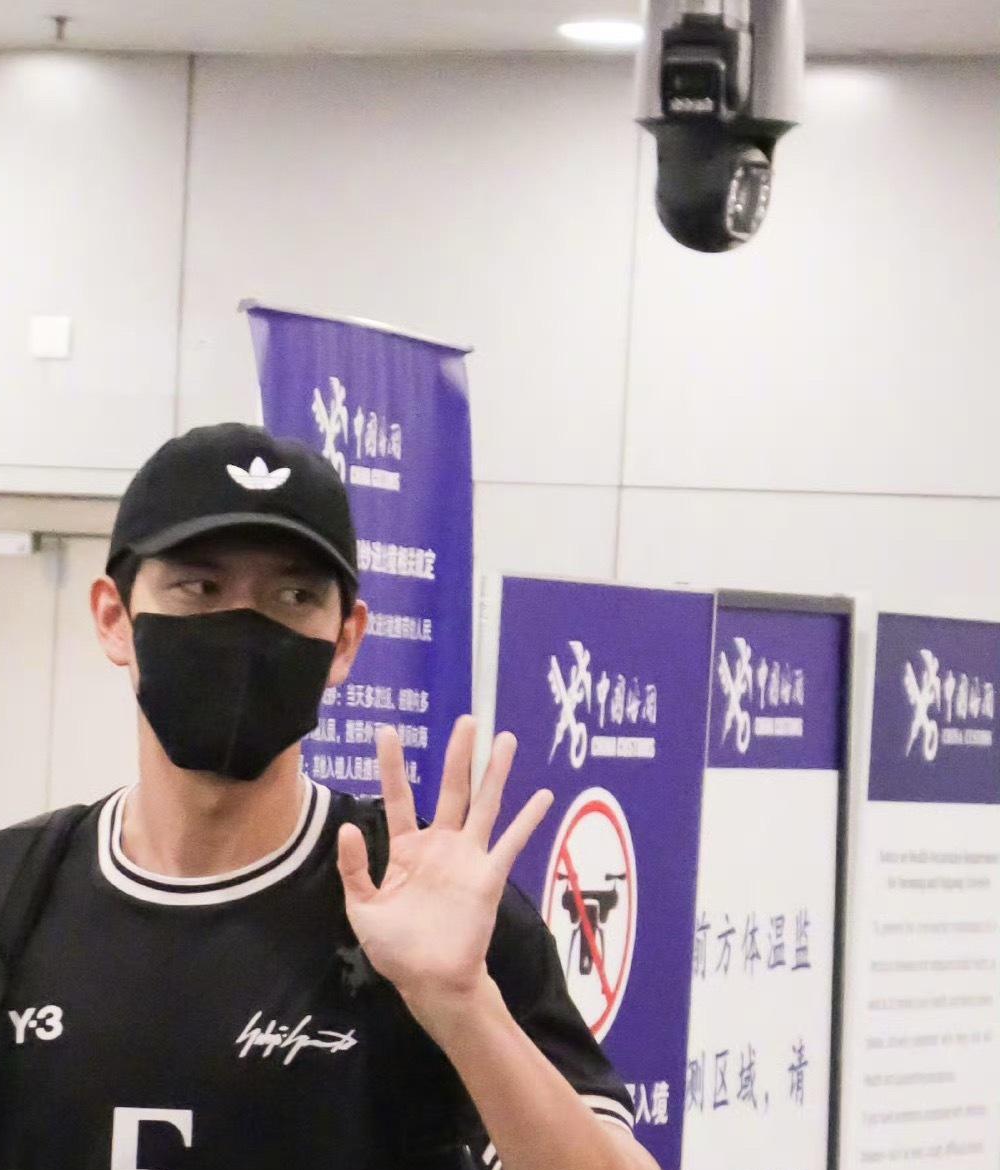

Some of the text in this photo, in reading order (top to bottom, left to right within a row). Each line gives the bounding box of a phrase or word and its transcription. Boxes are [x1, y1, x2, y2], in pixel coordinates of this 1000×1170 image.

[694, 911, 811, 980] 前方体温监
[8, 1005, 64, 1044] Y-3
